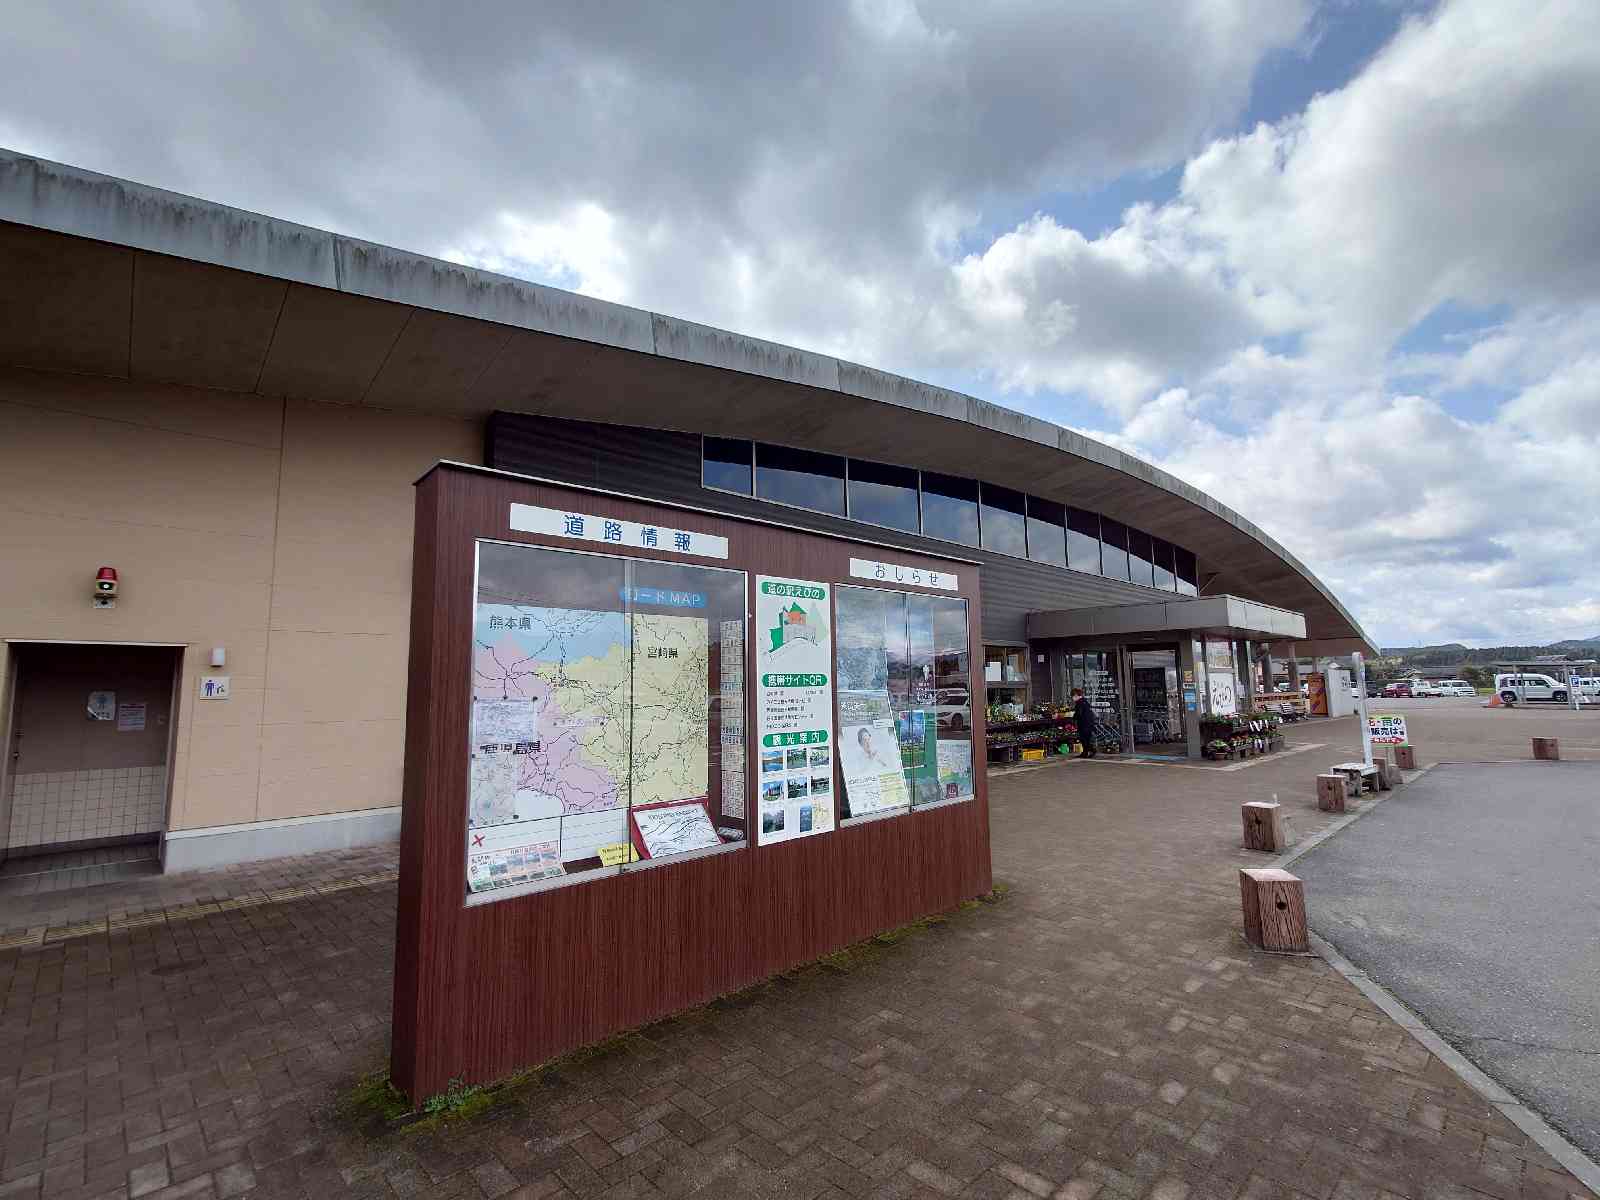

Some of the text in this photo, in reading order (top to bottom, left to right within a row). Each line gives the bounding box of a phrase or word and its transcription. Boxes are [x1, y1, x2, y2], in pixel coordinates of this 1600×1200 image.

[564, 514, 691, 552] 道路情報
[873, 561, 939, 587] おしらせ
[670, 591, 700, 606] MAP
[489, 616, 531, 631] 熊本県
[647, 645, 678, 659] 宮崎県
[772, 730, 820, 745] 観光案内
